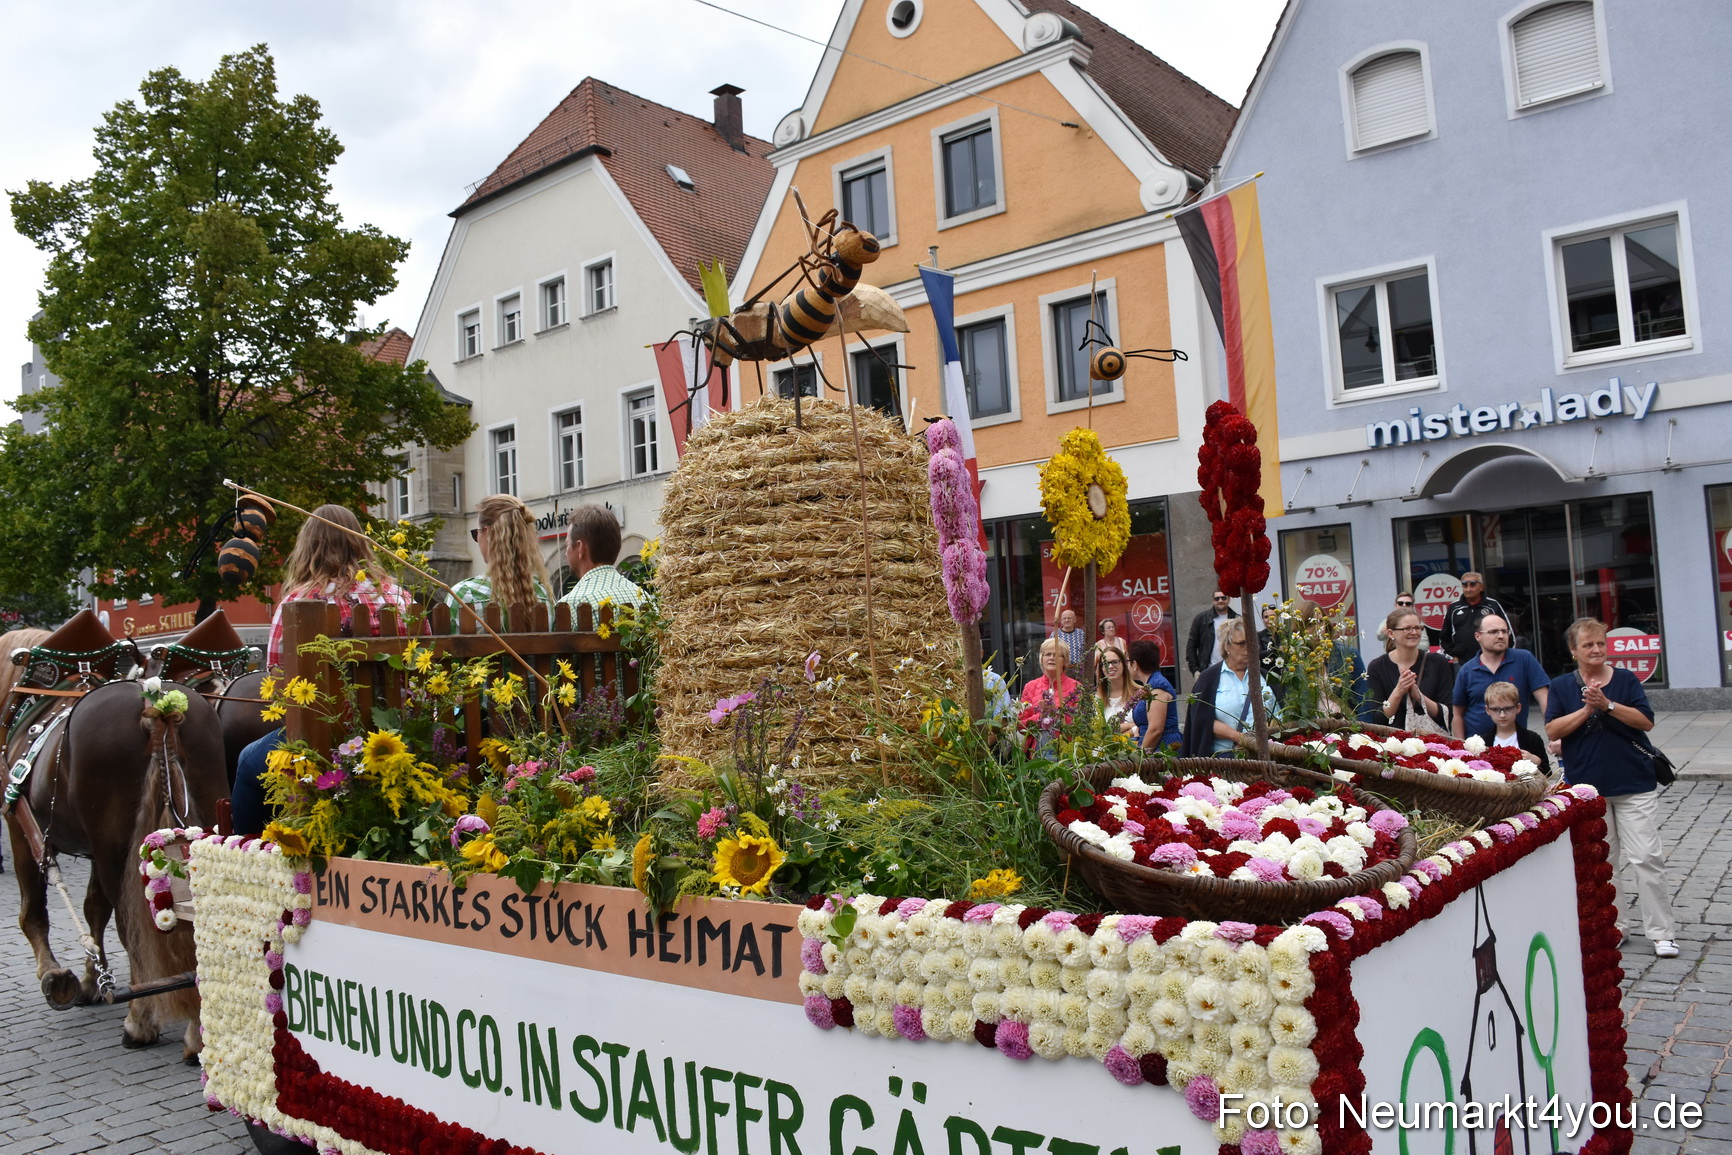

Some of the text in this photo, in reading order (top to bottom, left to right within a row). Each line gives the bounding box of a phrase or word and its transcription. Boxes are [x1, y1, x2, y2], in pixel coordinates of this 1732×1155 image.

[1366, 376, 1658, 448] mister lady
[1121, 576, 1169, 597] SALE
[1303, 583, 1341, 596] SALE
[159, 610, 198, 631] SCHLIE
[1613, 638, 1660, 652] SALE
[316, 869, 795, 979] EIN STARKES STÜCK HEIMAT
[285, 963, 381, 1058] BIENEN
[386, 990, 452, 1078] UND
[457, 1009, 513, 1097] CO.
[517, 1022, 563, 1111] IN
